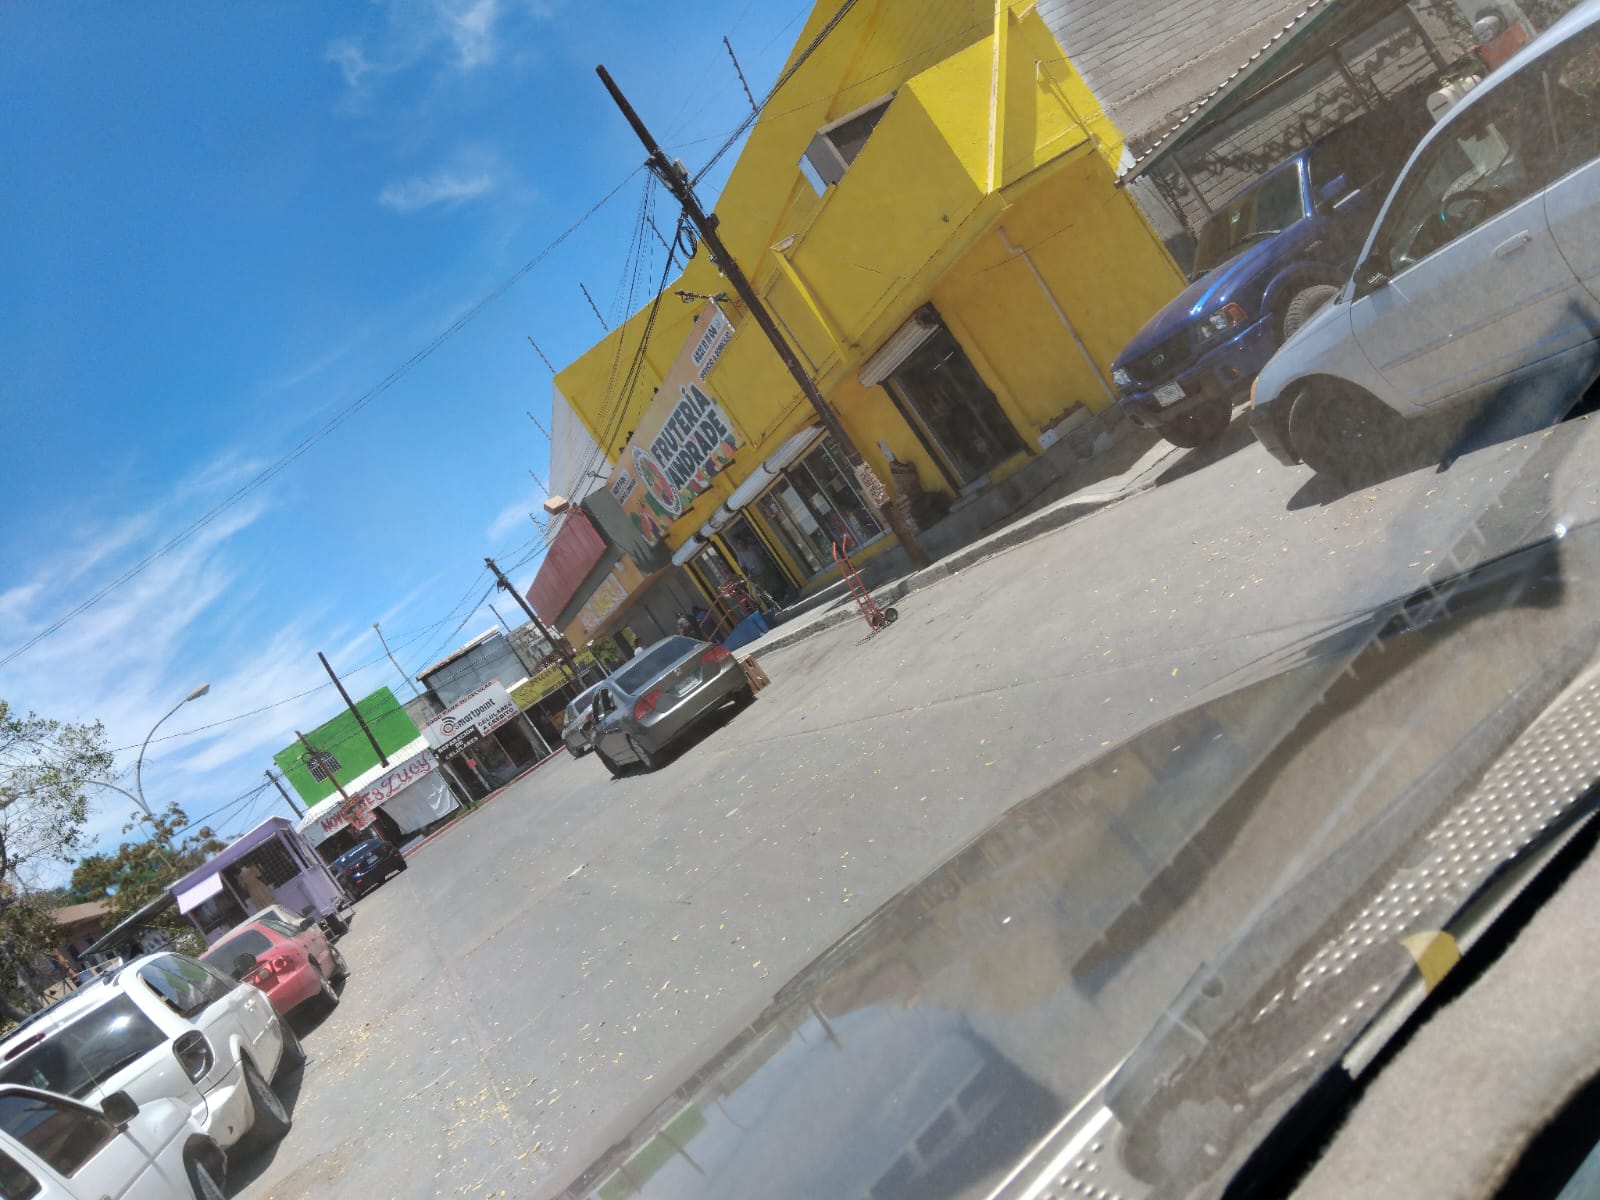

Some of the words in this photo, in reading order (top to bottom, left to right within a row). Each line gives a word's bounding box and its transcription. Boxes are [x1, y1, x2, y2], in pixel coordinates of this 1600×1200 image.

[650, 384, 711, 469] FRUTERÍA
[667, 408, 728, 490] ANDRADE
[453, 698, 496, 730] smartpoint
[455, 740, 464, 748] DE
